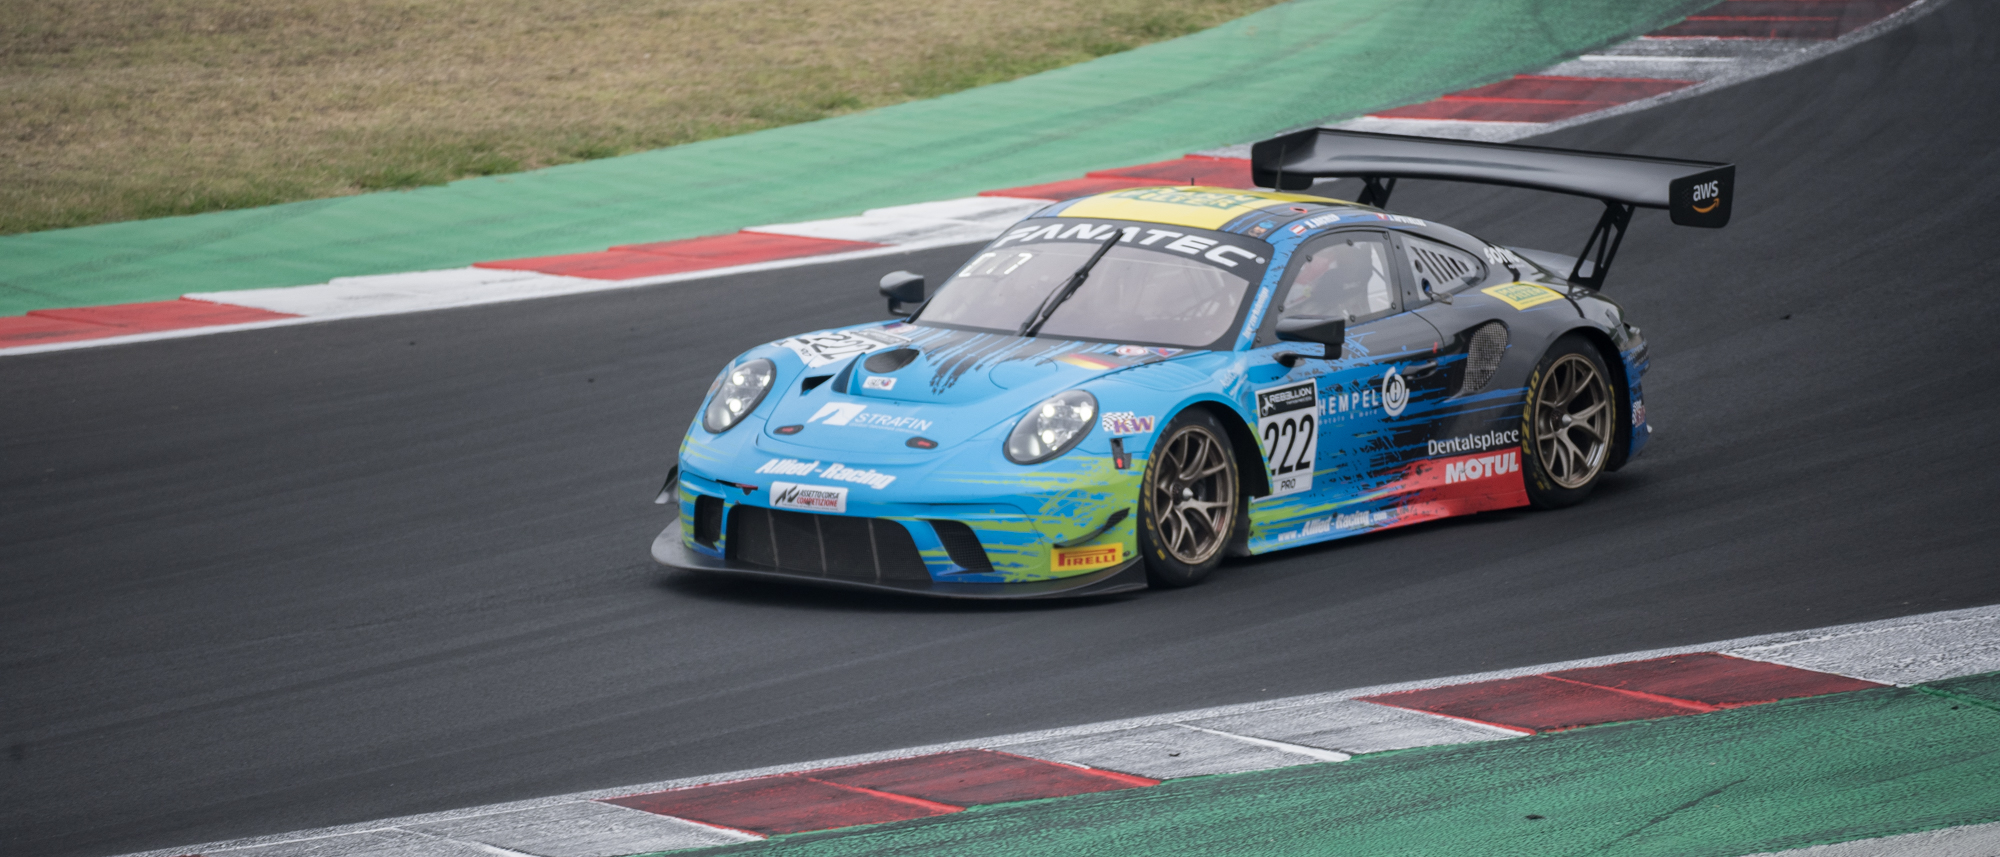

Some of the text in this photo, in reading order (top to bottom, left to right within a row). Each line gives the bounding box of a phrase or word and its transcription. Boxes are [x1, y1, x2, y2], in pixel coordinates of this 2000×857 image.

[1693, 180, 1719, 202] aws
[992, 222, 1258, 268] FANATEC
[1318, 388, 1379, 417] HEMPEL
[854, 412, 933, 432] STRAFIN
[1112, 415, 1155, 435] KW
[1264, 413, 1315, 477] 222
[1428, 428, 1520, 456] Dentalsplace
[1445, 452, 1520, 484] MOTUL
[799, 488, 840, 501] ASSETTO CORSA
[1280, 477, 1297, 491] PRO
[796, 496, 838, 508] COMPETIZIONE
[1058, 548, 1117, 567] PIRELLI
